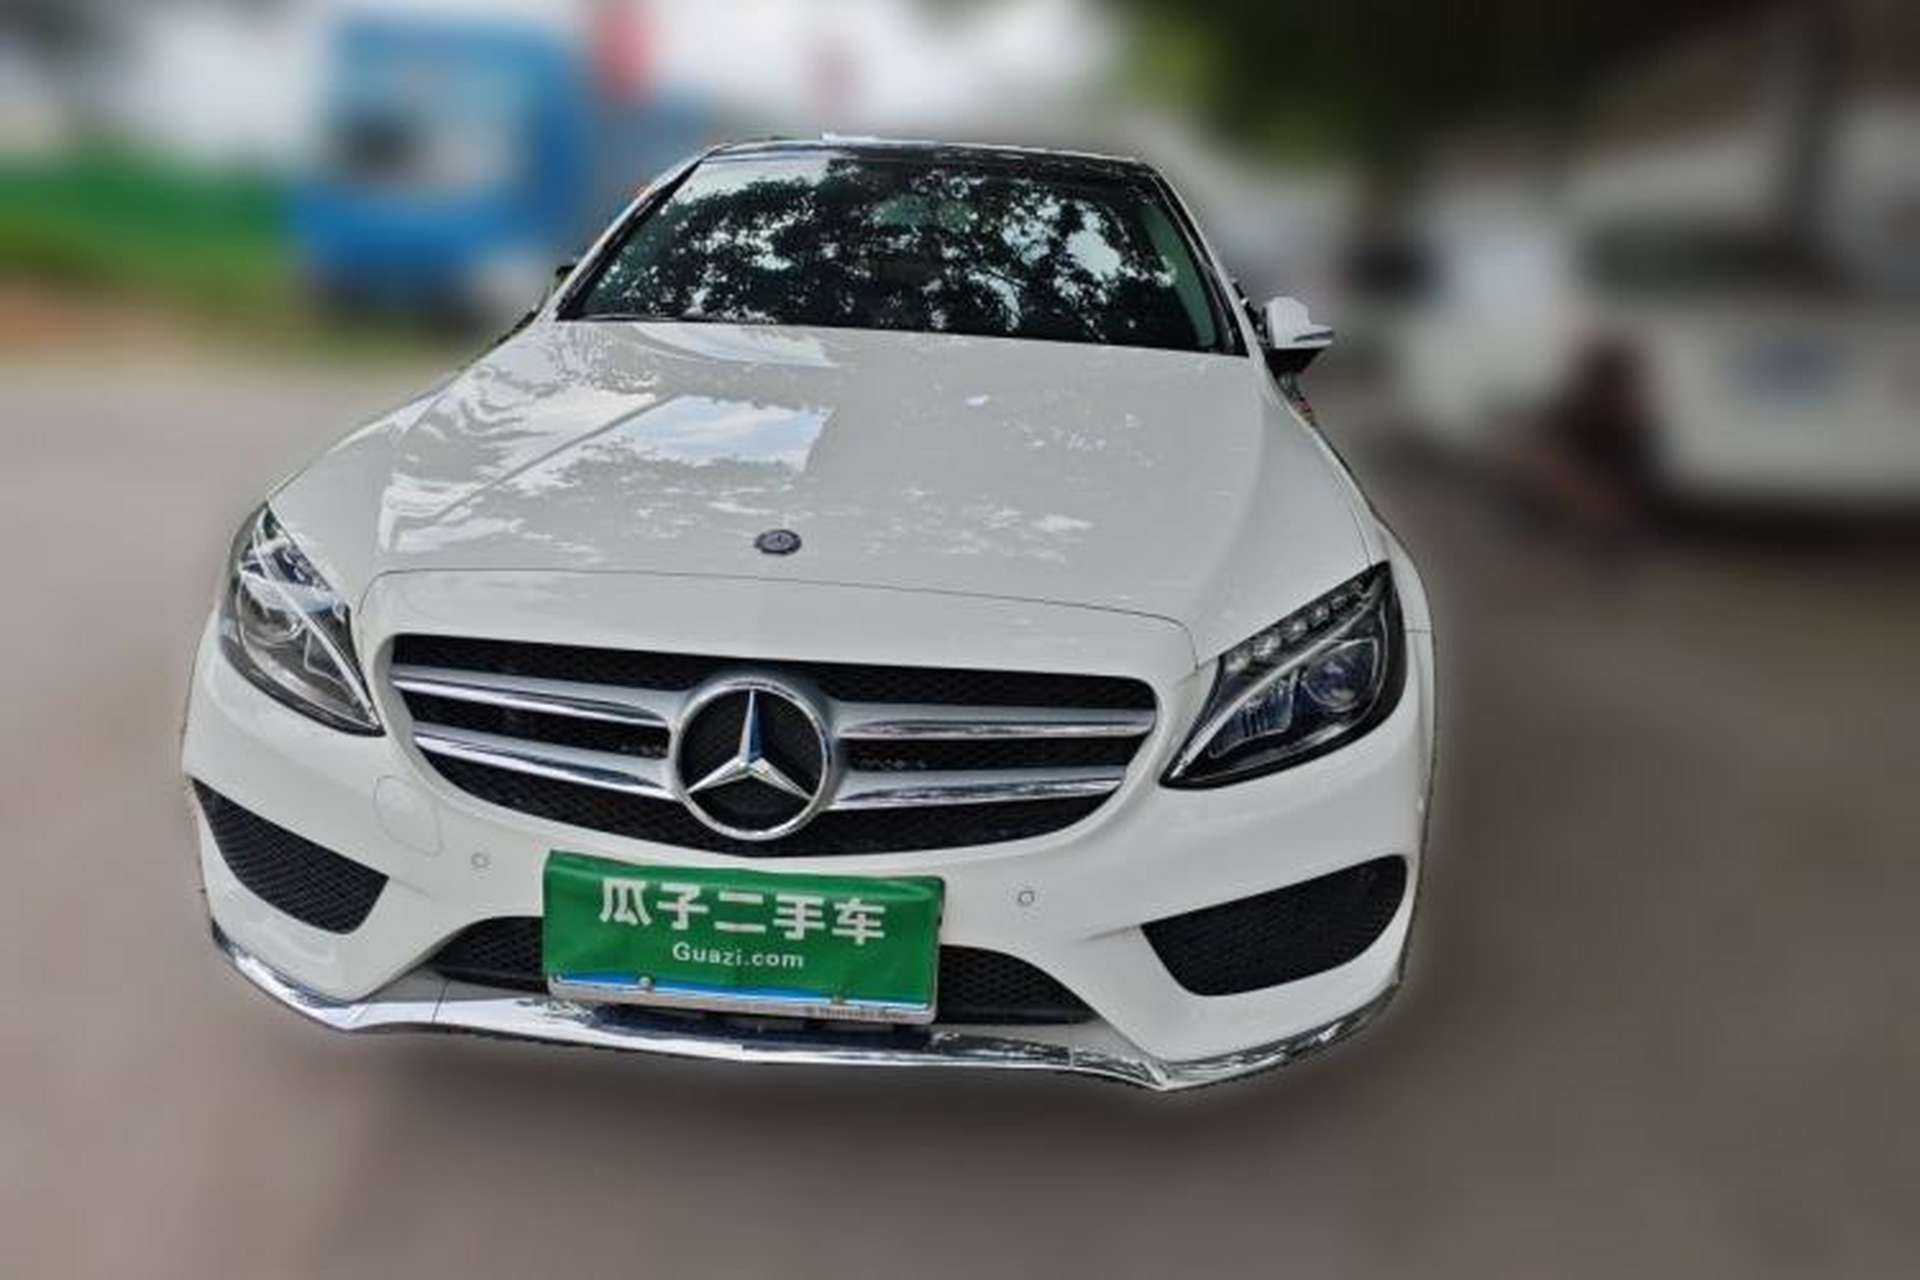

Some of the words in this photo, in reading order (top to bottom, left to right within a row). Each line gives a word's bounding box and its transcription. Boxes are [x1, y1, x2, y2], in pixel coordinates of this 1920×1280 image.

[599, 878, 886, 945] 瓜子二手车
[672, 942, 805, 969] Guazi.com
